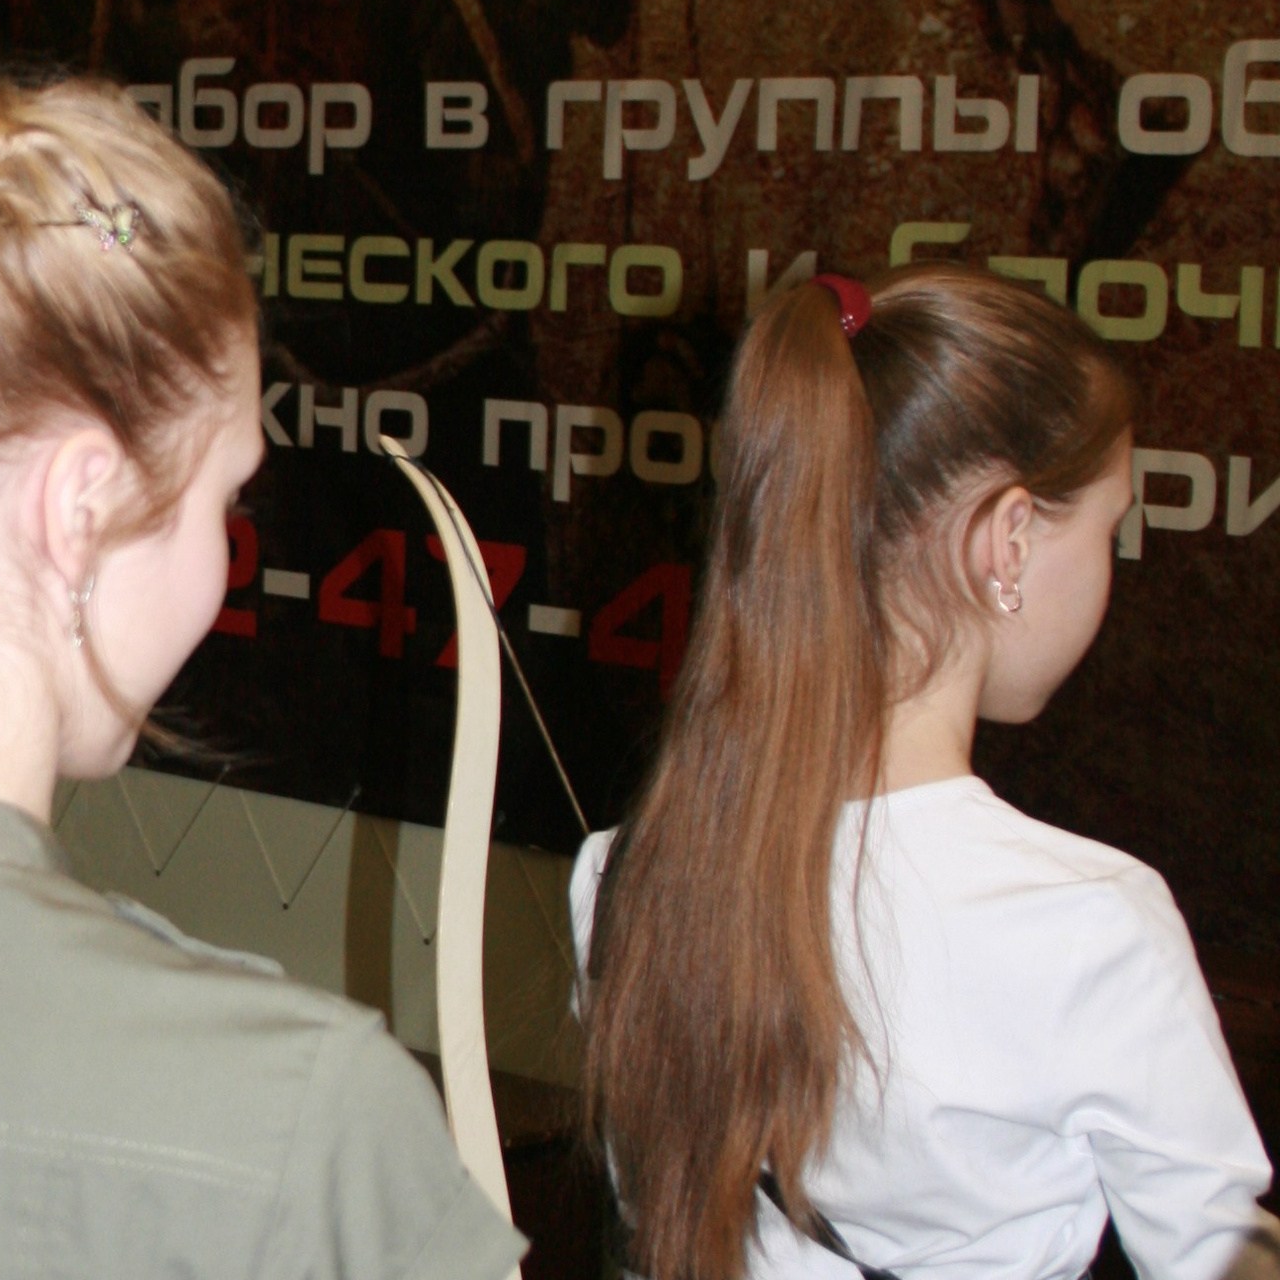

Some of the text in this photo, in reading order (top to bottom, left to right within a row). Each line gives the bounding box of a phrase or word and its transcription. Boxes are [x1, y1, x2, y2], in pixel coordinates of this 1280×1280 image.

[425, 80, 489, 149] в
[545, 74, 1041, 182] группы
[482, 397, 722, 504] про
